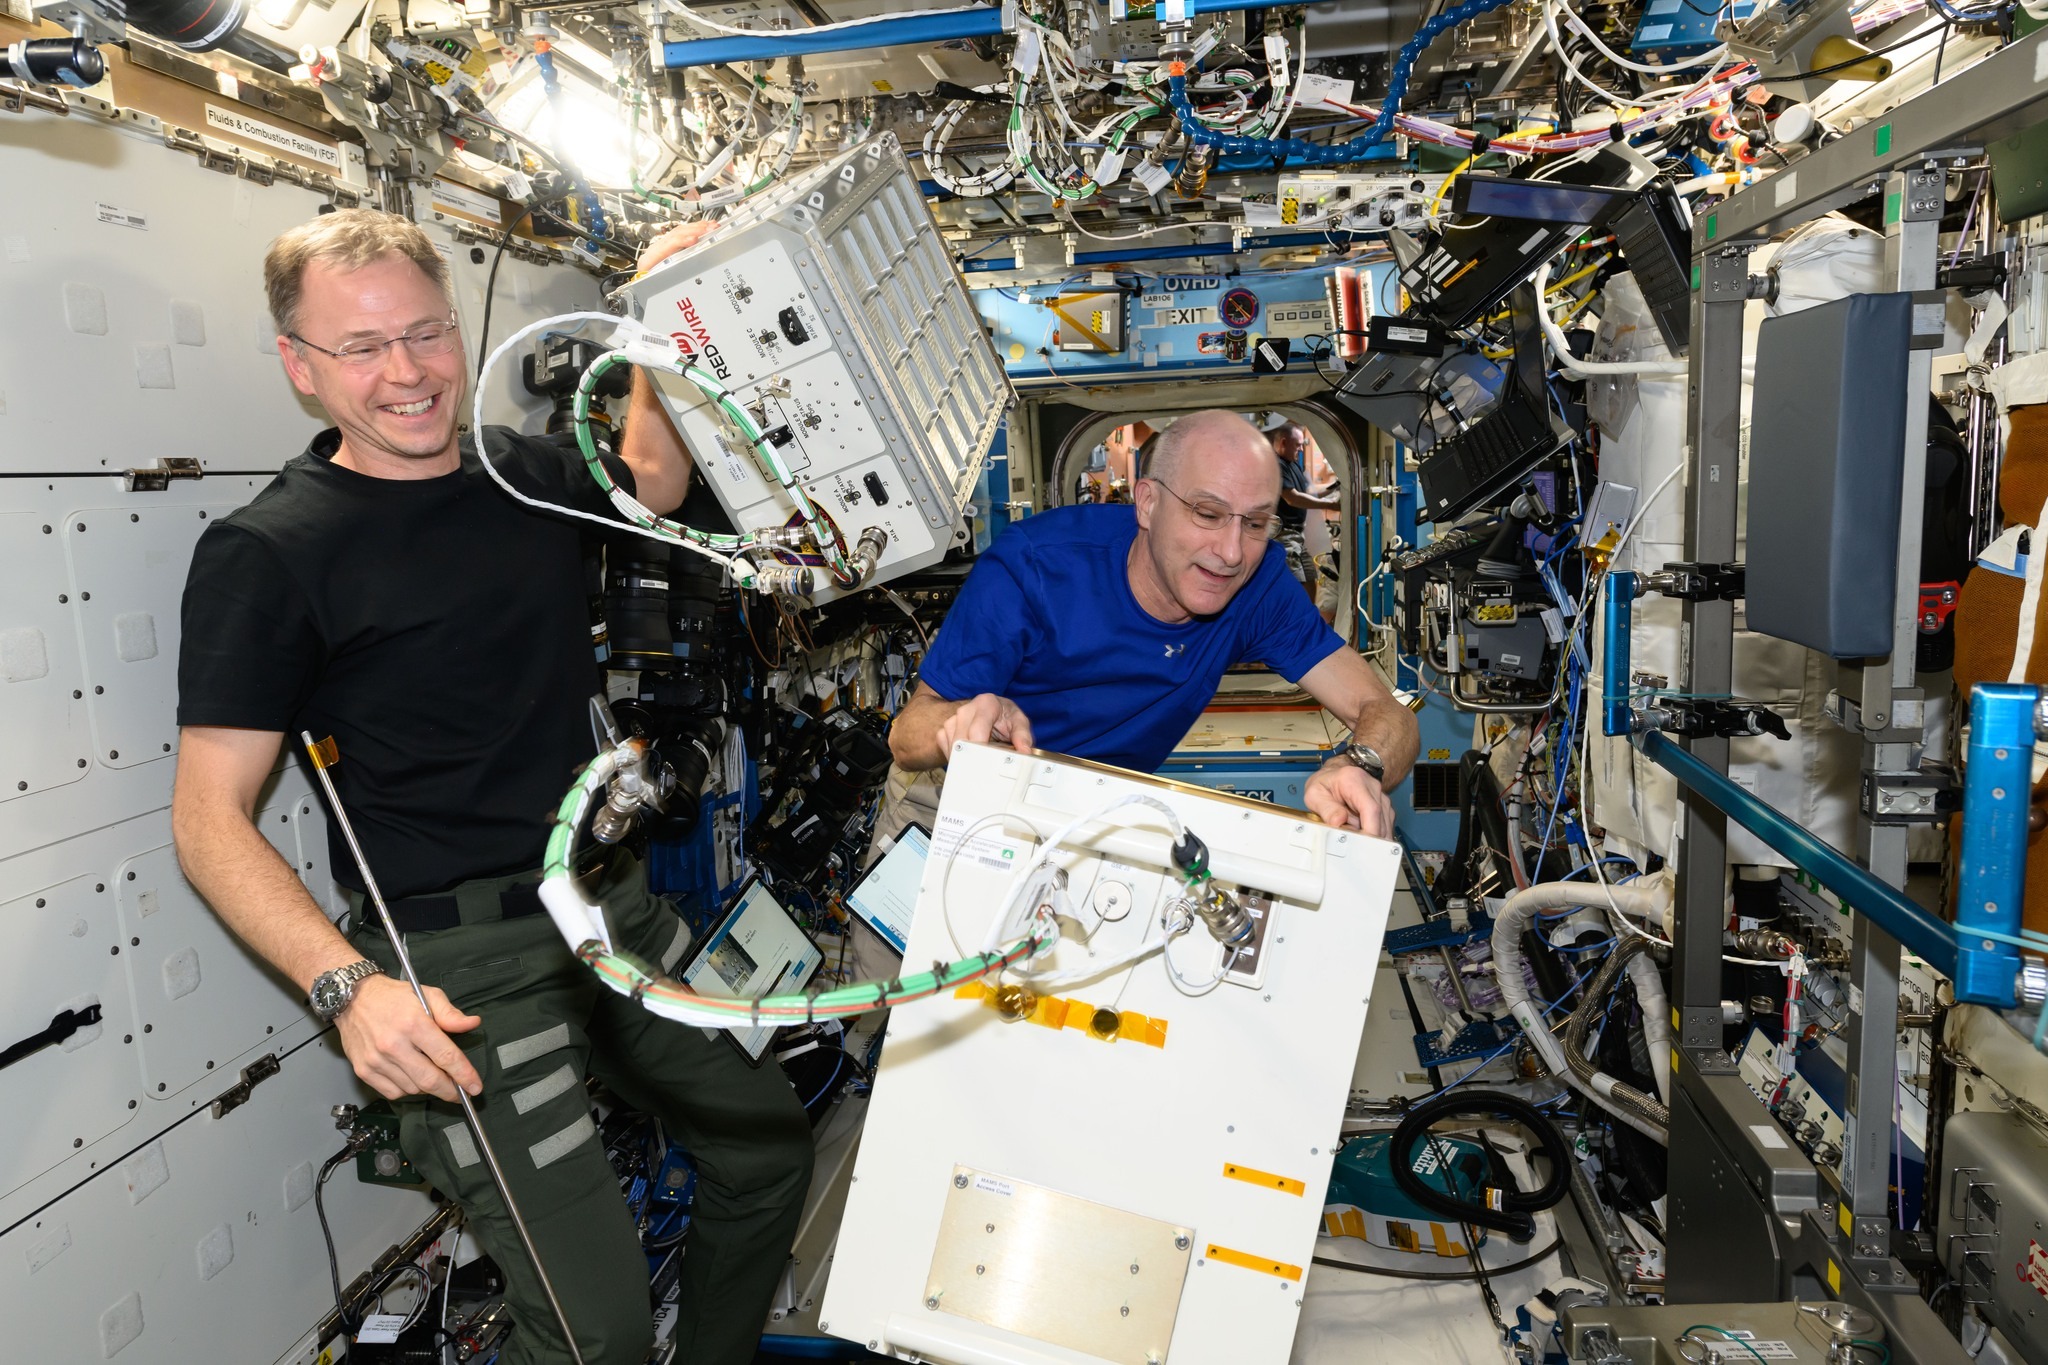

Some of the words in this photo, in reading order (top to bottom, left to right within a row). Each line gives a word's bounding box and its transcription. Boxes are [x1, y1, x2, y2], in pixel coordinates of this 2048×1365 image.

[208, 110, 234, 127] Fluids
[236, 120, 242, 130] &
[244, 122, 291, 146] Combustion
[292, 139, 318, 157] Facility
[319, 148, 338, 164] (FCF)
[724, 268, 738, 290] STATUS
[737, 274, 746, 286] OPS
[1165, 278, 1219, 292] OVHD
[725, 288, 743, 315] MODULE
[797, 305, 807, 317] END
[1335, 283, 1344, 329] ARNING
[677, 297, 732, 381] REDWIRE
[805, 322, 819, 340] START
[749, 333, 767, 359] MODULE
[794, 398, 806, 418] STATUS
[795, 418, 810, 439] MODULE
[834, 474, 847, 494] STATUS
[835, 492, 850, 514] MODULE
[889, 528, 900, 543] DATA
[1226, 790, 1272, 803] CK
[941, 815, 965, 827] MAMS
[797, 828, 815, 845] Canon
[1823, 914, 1842, 933] POWER
[1899, 974, 1922, 996] APTOP
[1924, 992, 1935, 1006] BU
[976, 1183, 995, 1192] Access
[995, 1188, 1012, 1197] Cover
[981, 1177, 998, 1186] MAMS
[998, 1182, 1010, 1190] Port
